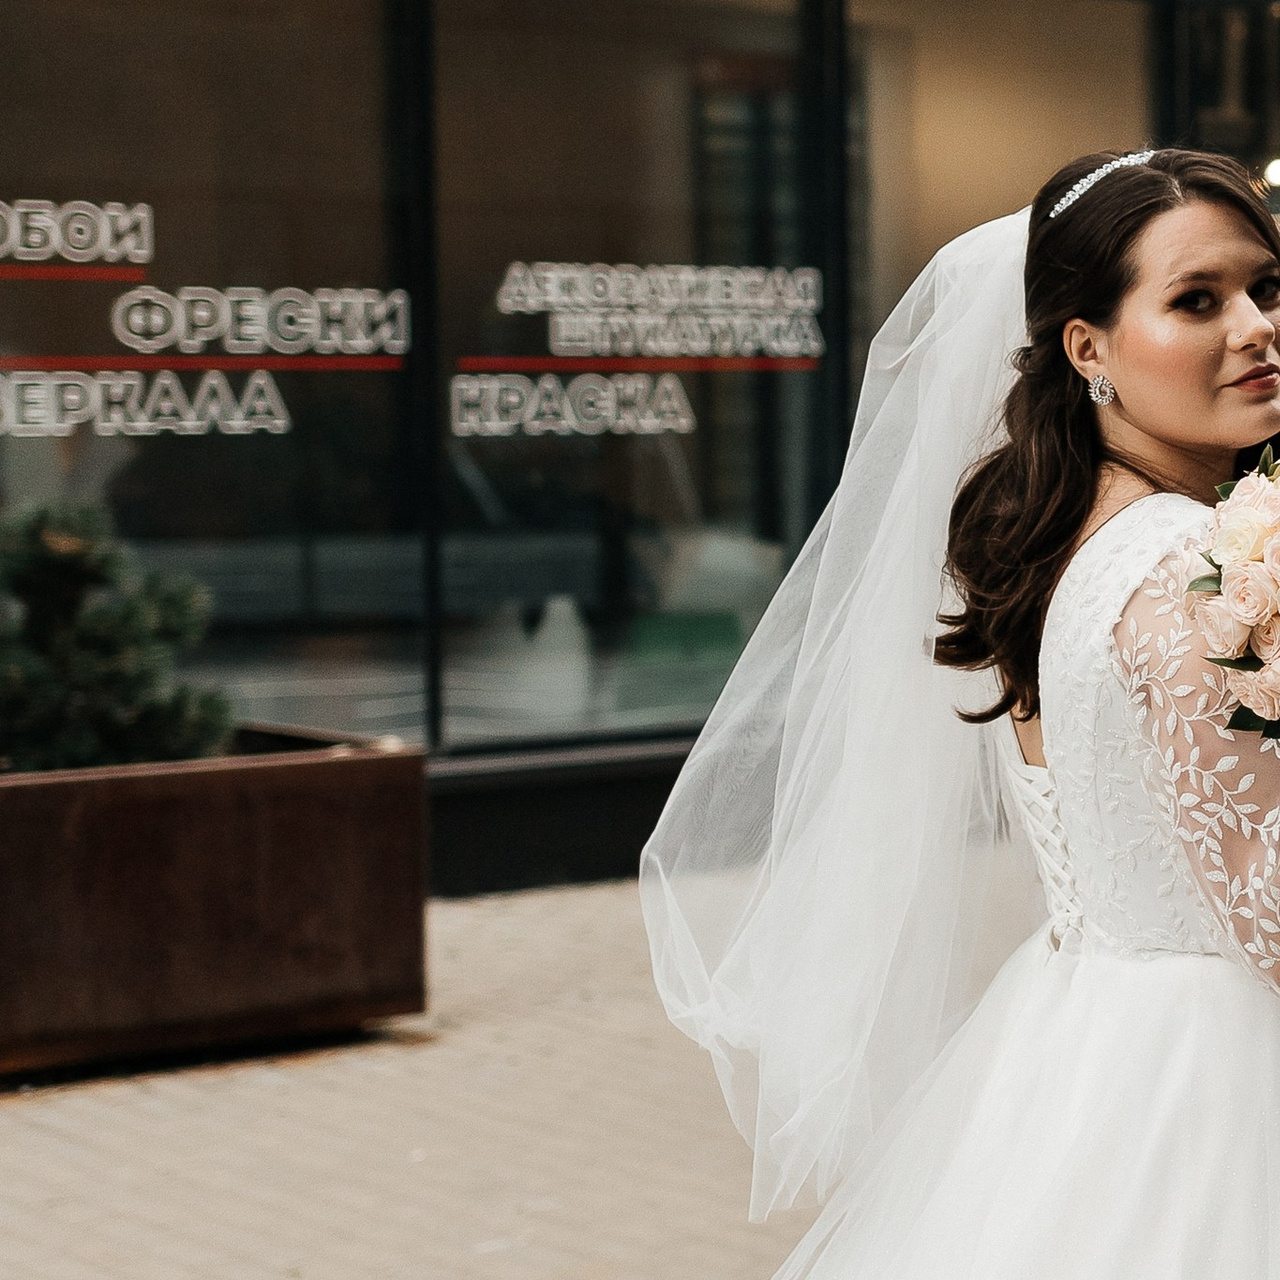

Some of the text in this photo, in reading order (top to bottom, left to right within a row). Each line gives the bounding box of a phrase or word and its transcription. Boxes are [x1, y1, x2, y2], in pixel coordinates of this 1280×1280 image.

[0, 199, 154, 263] БОИ
[110, 286, 411, 354] ФРЕСКИ
[0, 370, 292, 437] ЕРКАЛА
[451, 373, 697, 437] КРАСКА
